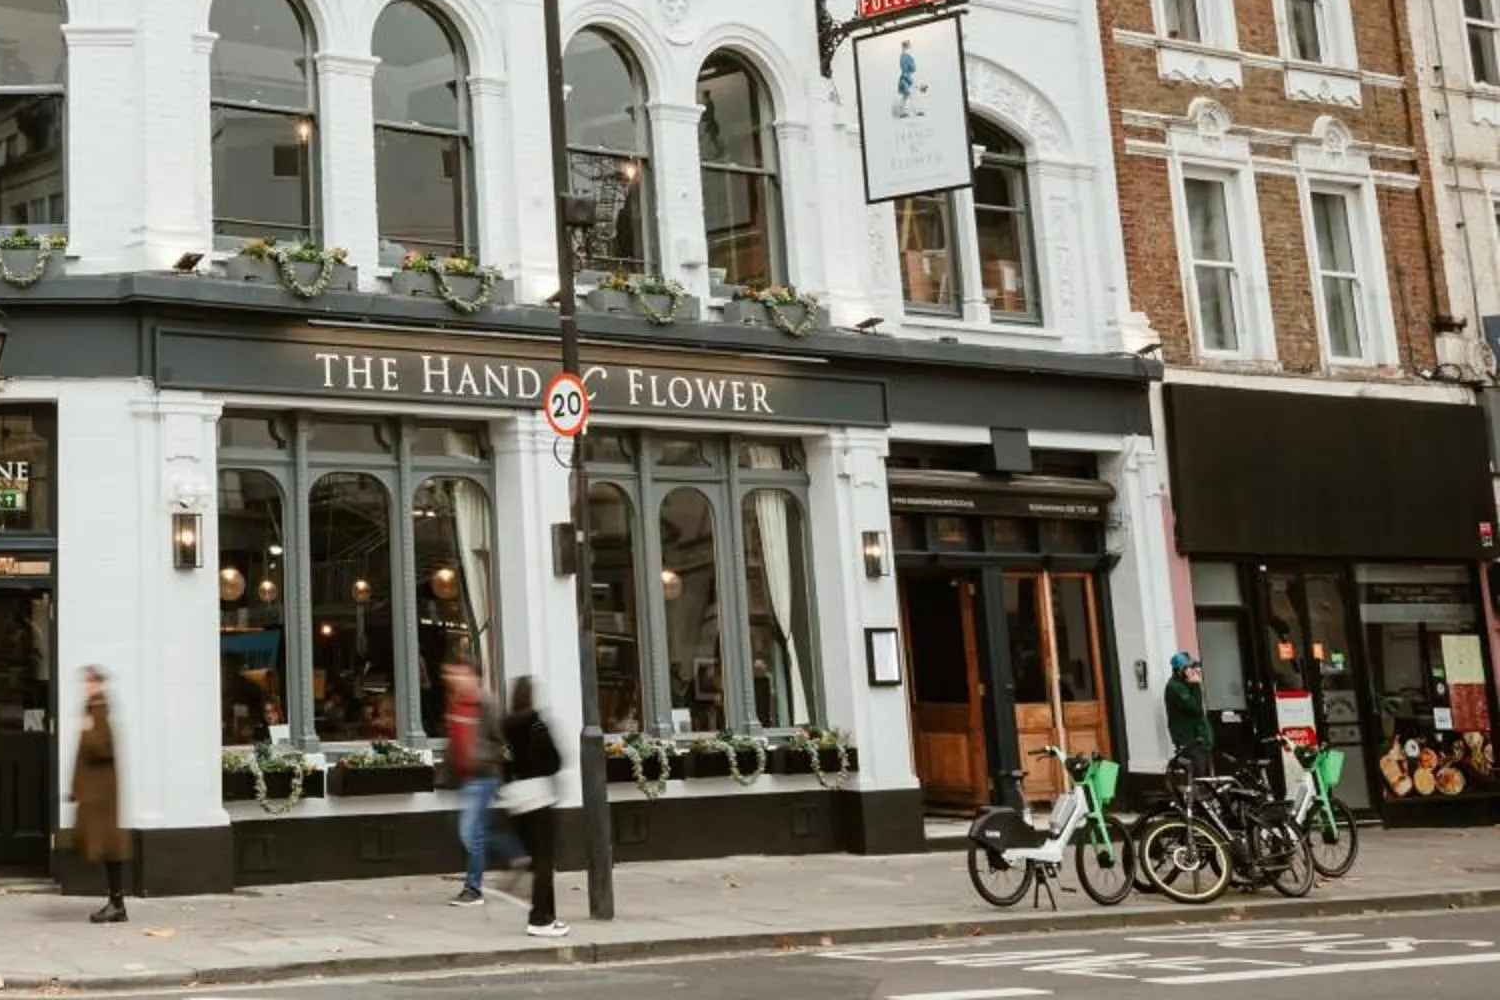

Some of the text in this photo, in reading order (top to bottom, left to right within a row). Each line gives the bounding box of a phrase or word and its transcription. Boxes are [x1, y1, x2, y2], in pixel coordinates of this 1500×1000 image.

[315, 353, 399, 391] THE
[421, 355, 541, 399] HAND
[627, 368, 774, 413] FLOWER
[552, 391, 581, 417] 20
